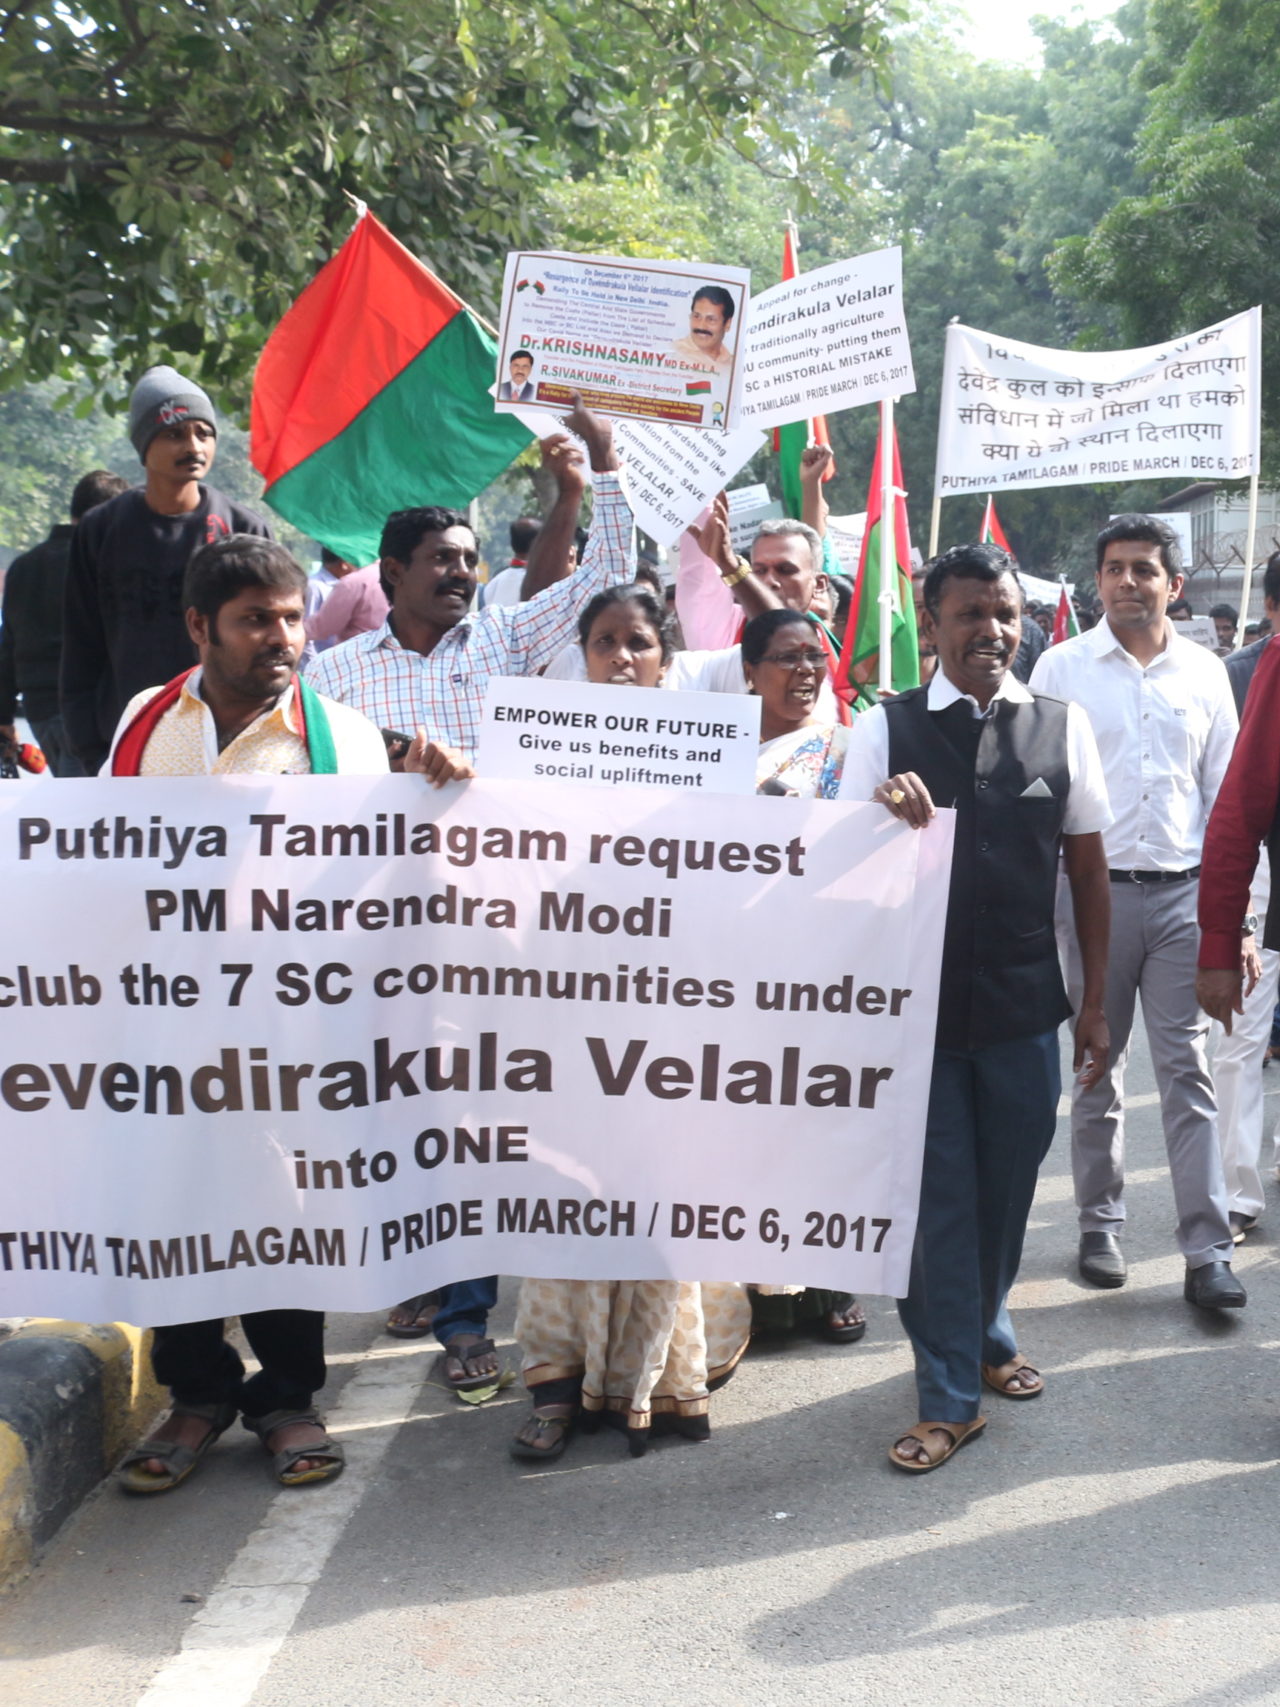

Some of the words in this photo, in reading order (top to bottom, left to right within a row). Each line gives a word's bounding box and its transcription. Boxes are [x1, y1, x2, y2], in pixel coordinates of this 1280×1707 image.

[793, 287, 808, 297] for
[811, 273, 851, 292] change
[746, 301, 831, 335] endirakula
[837, 283, 895, 307] Velalar
[520, 334, 665, 367] Dr.KRISHNASAMY
[751, 327, 817, 352] traditionally
[821, 310, 884, 334] agriculture
[827, 333, 868, 354] putting
[871, 326, 901, 340] them
[540, 364, 617, 387] R.SIVAKUMAR
[745, 380, 761, 393] SC
[763, 380, 770, 388] a
[773, 361, 835, 385] HISTORIAL
[839, 346, 893, 368] MISTAKE
[757, 392, 800, 412] TAMILAGAM
[806, 386, 829, 401] PRIDE
[831, 379, 858, 394] MARCH
[864, 373, 879, 386] DEC
[880, 371, 889, 382] 6,
[890, 365, 908, 379] 2017
[1007, 377, 1046, 399] कुल
[1054, 377, 1084, 398] को
[1163, 356, 1246, 381] दिलाएगा
[957, 402, 1038, 429] संविधान
[1046, 408, 1065, 429] में
[1070, 408, 1093, 424] जो
[1101, 399, 1150, 421] मिला
[1157, 393, 1180, 410] था
[1190, 385, 1246, 408] हमको
[636, 420, 661, 443] ation
[662, 439, 685, 461] from
[685, 459, 700, 476] the
[702, 431, 728, 458] being
[981, 441, 1019, 462] क्या
[1078, 427, 1130, 448] स्थान
[1137, 421, 1223, 442] दिलाएगा
[619, 425, 675, 476] Communities
[680, 477, 706, 503] SAVE
[626, 452, 674, 499] VELALAR
[709, 461, 727, 478] like
[941, 474, 997, 489] PUTHIYA
[1001, 463, 1078, 483] TAMILAGAM
[1090, 460, 1130, 475] PRIDE
[1132, 456, 1180, 472] MARCH
[1190, 455, 1215, 470] DEC
[1217, 456, 1229, 472] 6,
[1231, 453, 1254, 470] 2017
[639, 488, 657, 506] DEC
[662, 509, 684, 529] 2017
[494, 706, 598, 729] EMPOWER
[605, 715, 649, 733] OUR
[656, 719, 738, 739] FUTURE
[519, 733, 562, 751] Give
[570, 740, 591, 754] us
[599, 740, 679, 760] benefits
[686, 749, 721, 763] and
[534, 762, 593, 779] social
[601, 766, 703, 787] upliftment
[18, 816, 228, 870] Puthiya
[249, 813, 567, 867] Tamilagam
[589, 834, 806, 879] request
[145, 888, 227, 932] PM
[251, 885, 517, 932] Narendra
[539, 891, 672, 938] Modi
[120, 963, 200, 1007] the
[220, 963, 253, 1007] 7
[275, 963, 353, 1007] SC
[373, 962, 735, 1008] communities
[755, 975, 912, 1017] under
[0, 1032, 553, 1115] evendirakula
[585, 1037, 895, 1109] Velalar
[294, 1148, 397, 1190] into
[414, 1126, 529, 1169] ONE
[0, 1231, 99, 1276] THIYA
[105, 1227, 346, 1280] TAMILAGAM
[381, 1200, 483, 1261] PRIDE
[496, 1198, 636, 1237] MARCH
[671, 1203, 746, 1241] DEC
[758, 1208, 790, 1252] 6,
[802, 1211, 893, 1253] 2017
